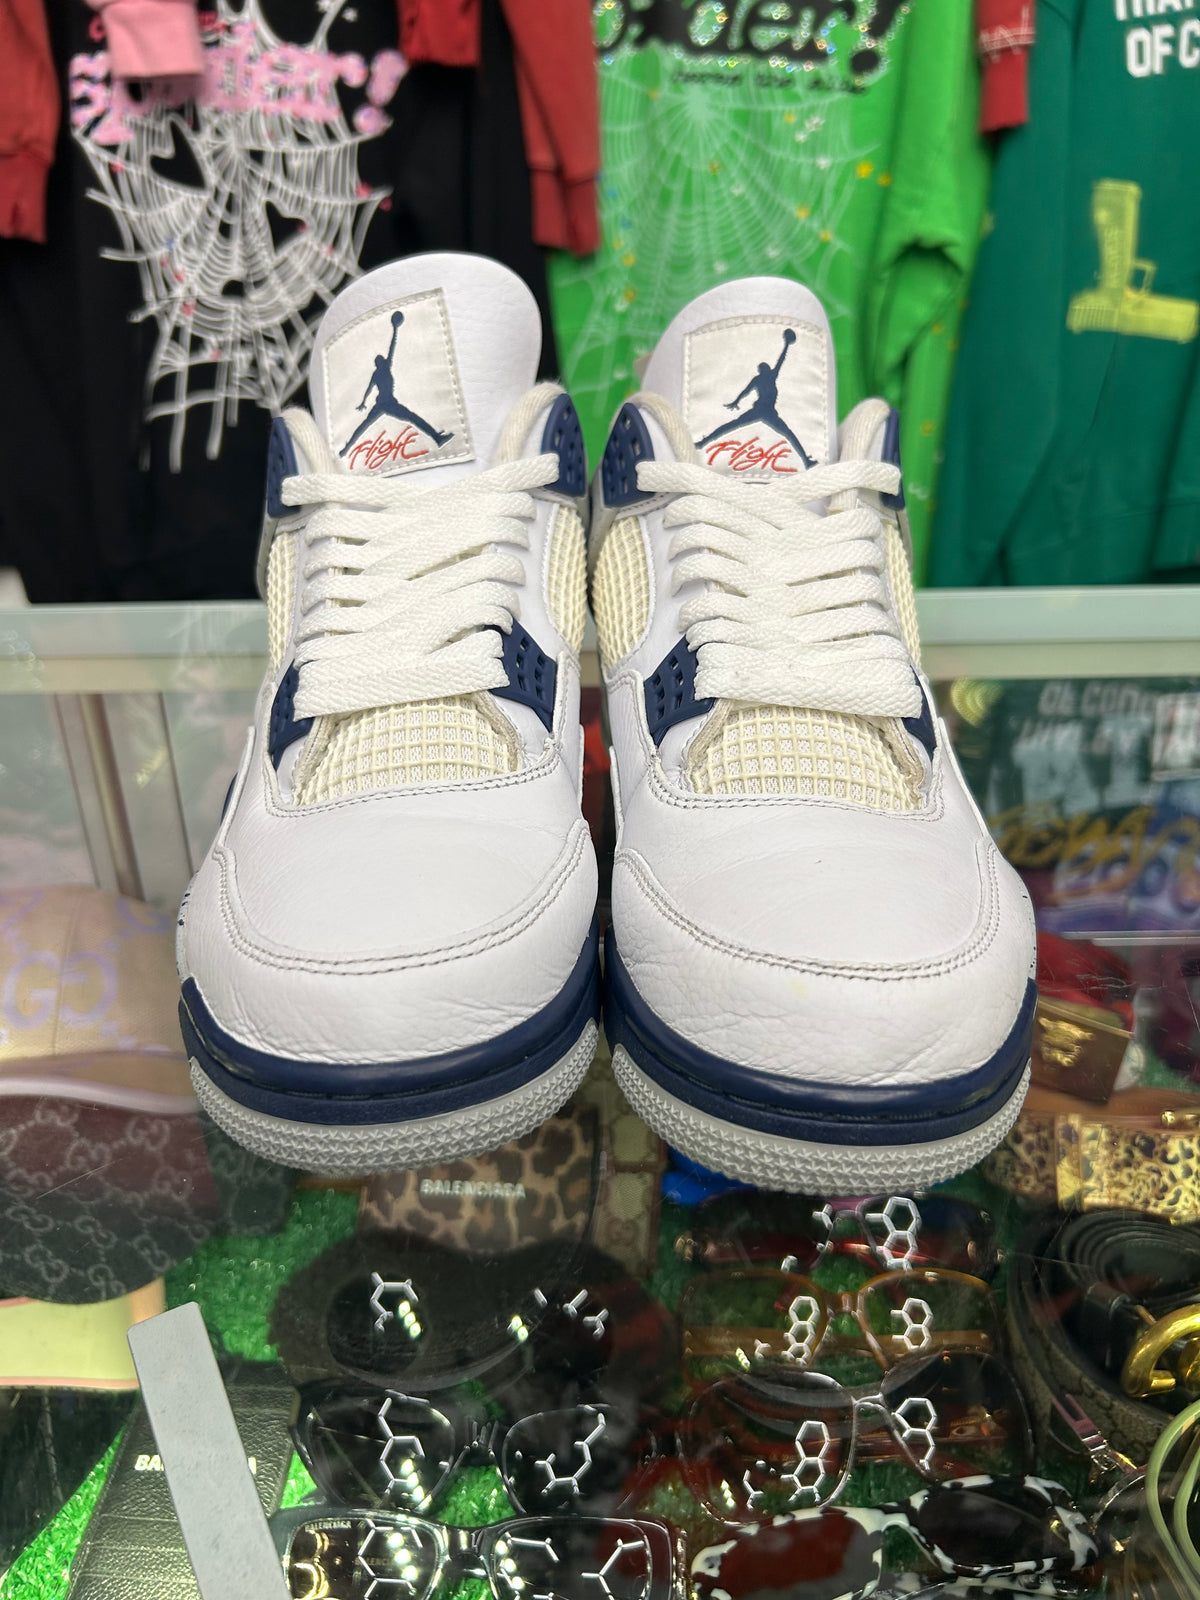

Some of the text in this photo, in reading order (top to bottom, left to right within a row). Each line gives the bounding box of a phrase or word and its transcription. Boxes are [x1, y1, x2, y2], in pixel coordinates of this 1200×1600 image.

[1126, 24, 1174, 78] OF
[348, 425, 429, 470] Flight
[706, 436, 798, 472] Flight
[421, 1178, 526, 1199] BALENCIAGA
